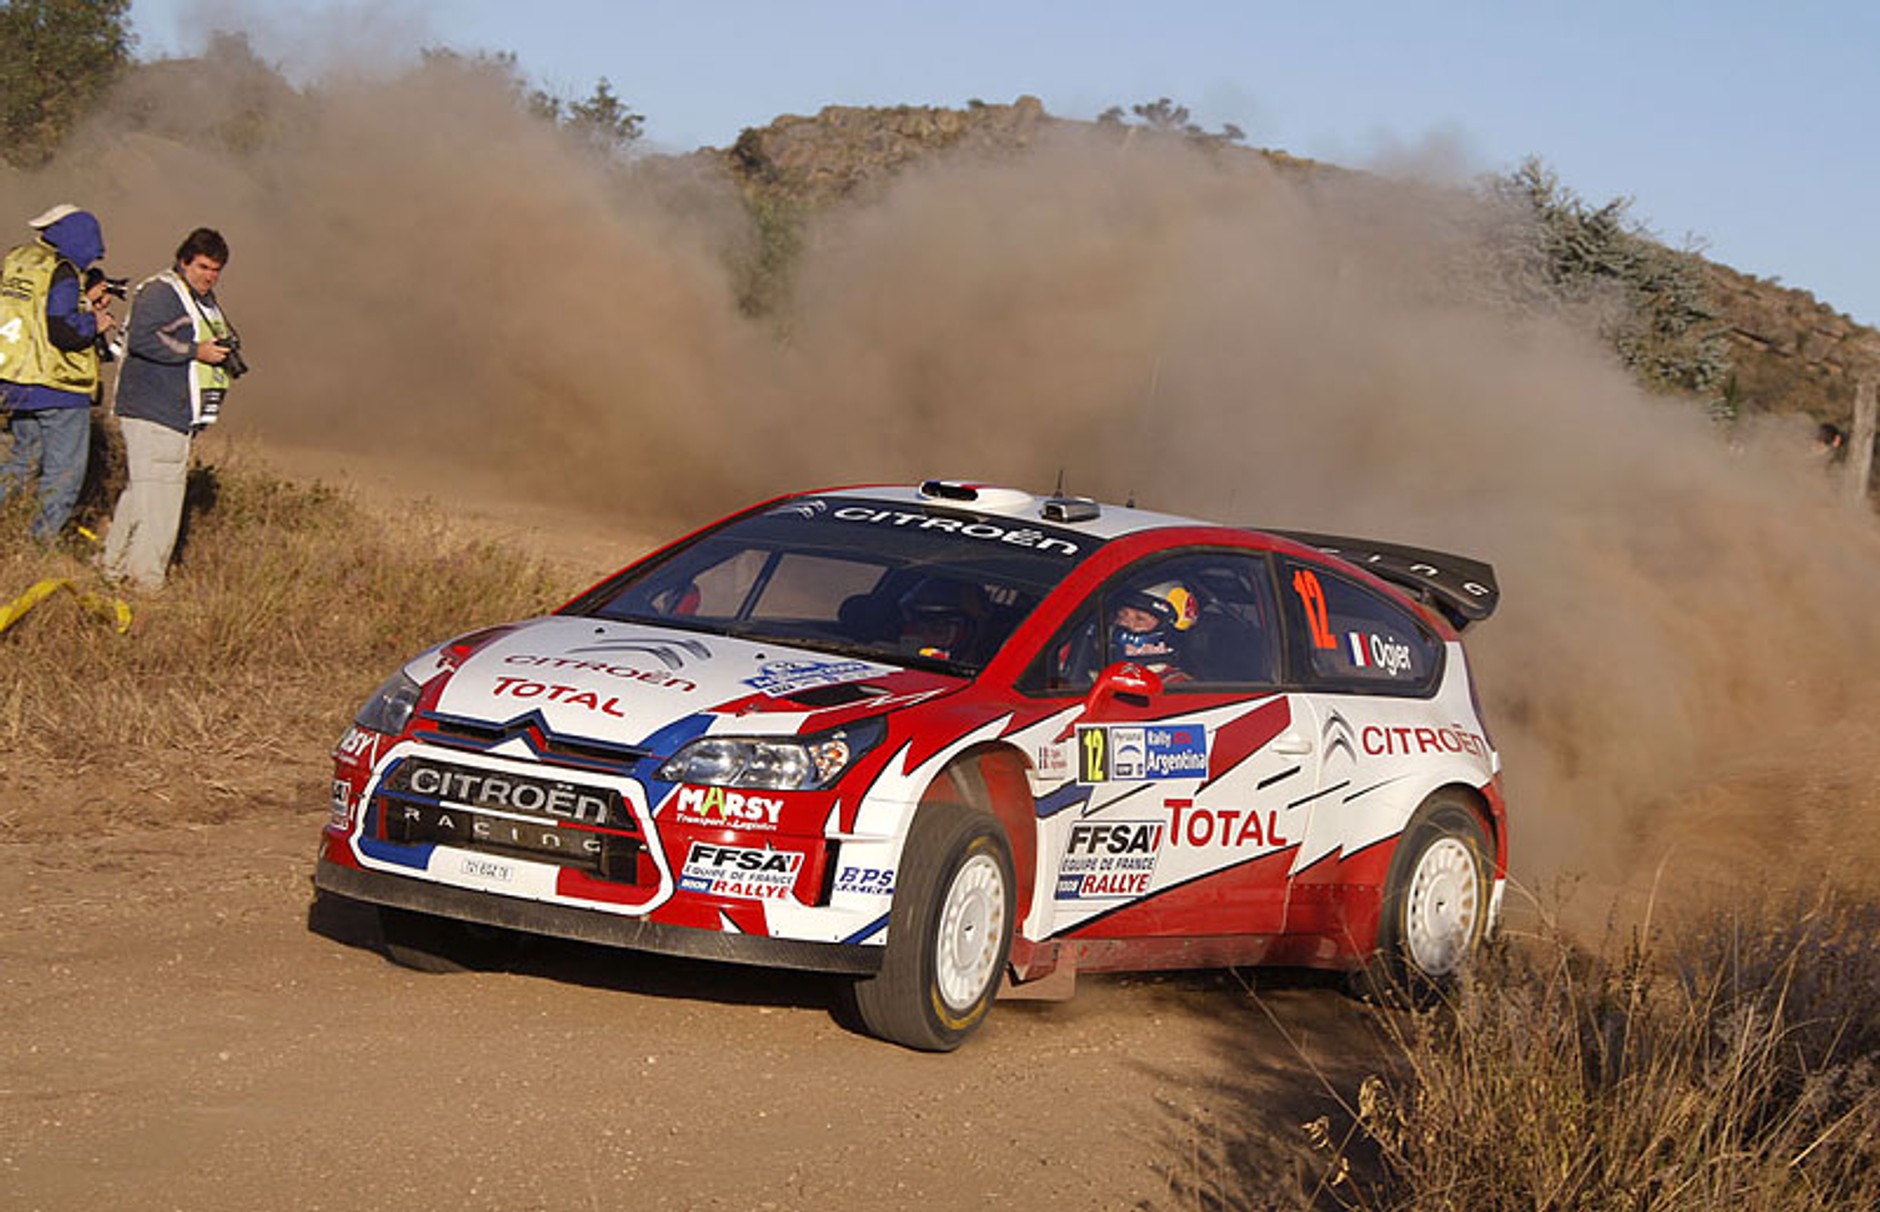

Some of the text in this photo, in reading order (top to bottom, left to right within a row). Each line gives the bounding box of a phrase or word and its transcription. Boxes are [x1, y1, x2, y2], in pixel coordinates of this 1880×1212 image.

[1292, 569, 1338, 649] 12
[1370, 634, 1411, 676] Ogier
[493, 677, 624, 718] TOTAL
[1147, 730, 1171, 748] Rally
[1083, 729, 1104, 781] 12
[1147, 749, 1205, 775] Argentina
[677, 787, 783, 823] MARSY
[1164, 798, 1287, 847] TOTAL
[1068, 825, 1150, 854] FFSA
[689, 845, 786, 872] FFSA
[1062, 857, 1155, 872] EQUIPE DE FRANCE
[685, 865, 793, 885] EQUIPE DE FRANCE
[839, 866, 894, 886] BPS
[1081, 873, 1150, 894] RALLYE
[712, 880, 789, 899] RALLYE
